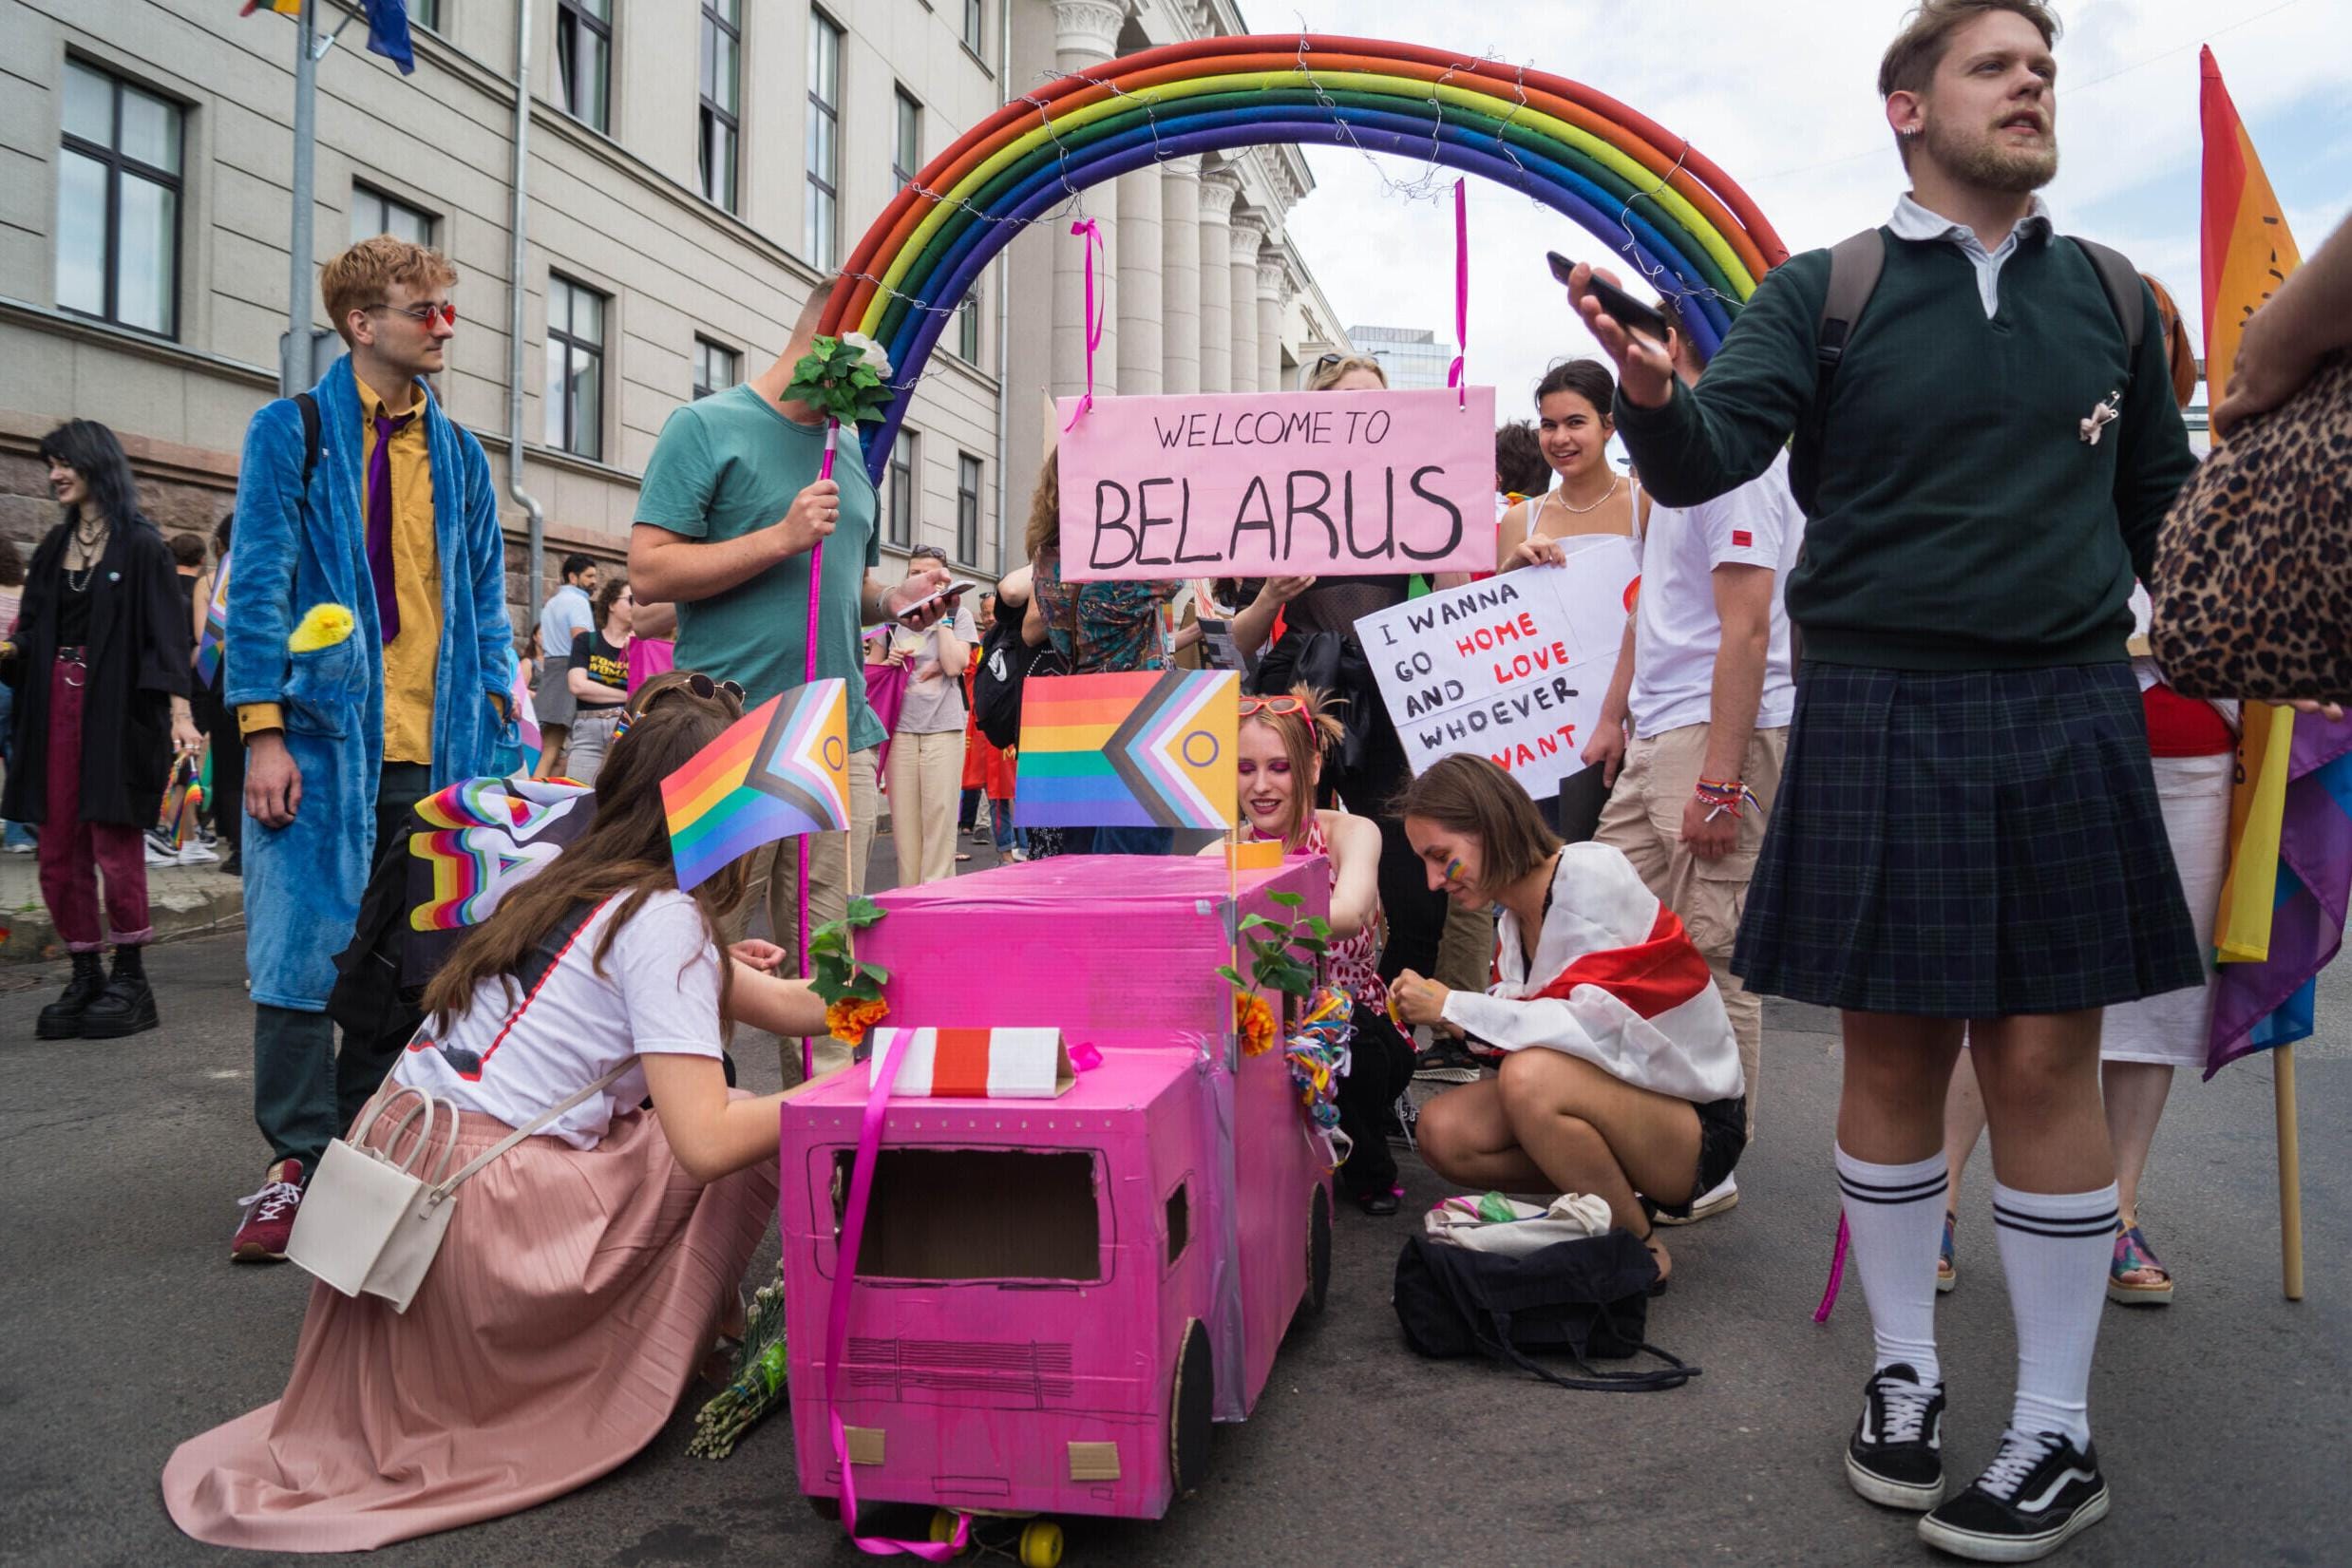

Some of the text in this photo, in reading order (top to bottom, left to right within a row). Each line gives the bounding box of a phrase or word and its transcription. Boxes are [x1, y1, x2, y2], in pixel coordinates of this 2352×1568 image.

[1154, 410, 1391, 448] WELCOME TO
[1090, 465, 1463, 569] BELARUS
[1379, 583, 1520, 646] I WANNA
[1394, 613, 1538, 682] GO HOME
[589, 662, 629, 677] WOMA
[1406, 641, 1569, 718] AND LOVE
[1419, 676, 1580, 749] WHOEVER
